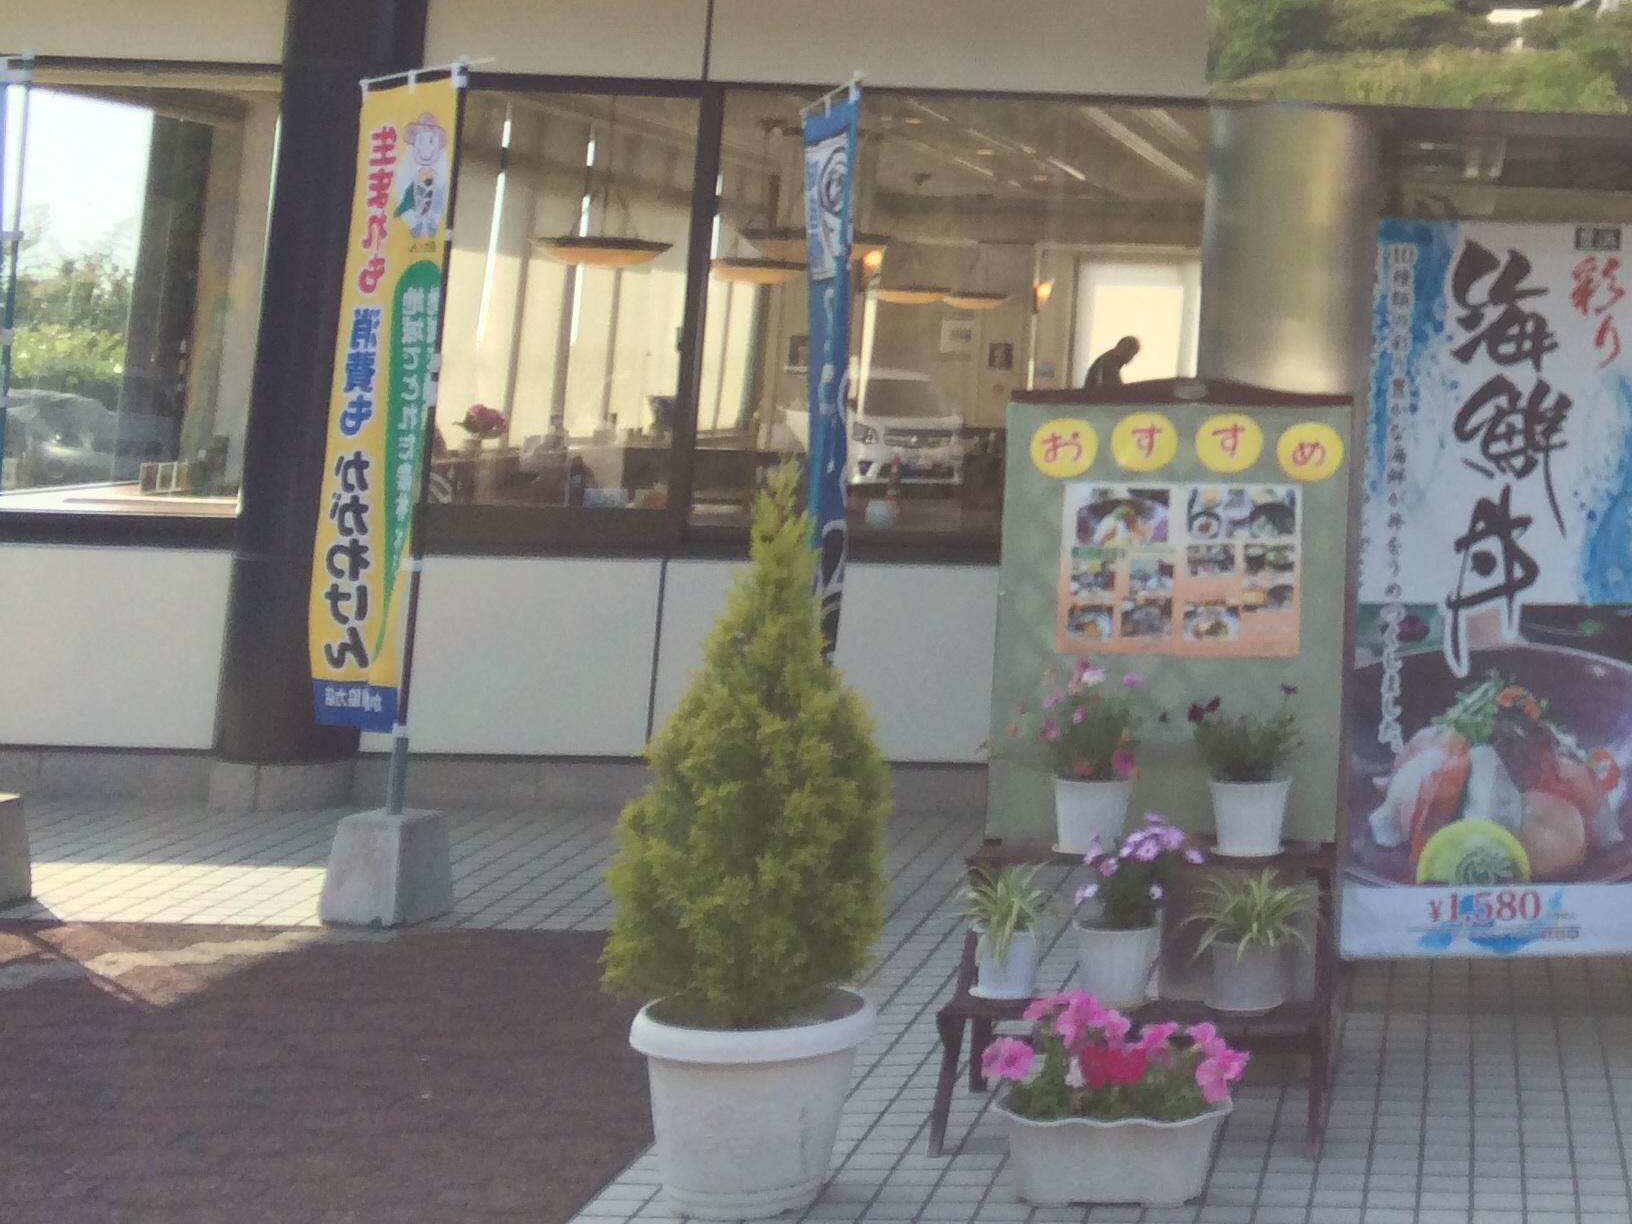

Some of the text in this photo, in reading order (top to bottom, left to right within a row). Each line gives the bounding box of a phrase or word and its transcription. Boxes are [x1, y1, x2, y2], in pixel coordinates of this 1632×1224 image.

[1569, 255, 1626, 368] 彩り
[1041, 423, 1327, 466] おすすめ
[1445, 238, 1573, 674] 海鮮丼
